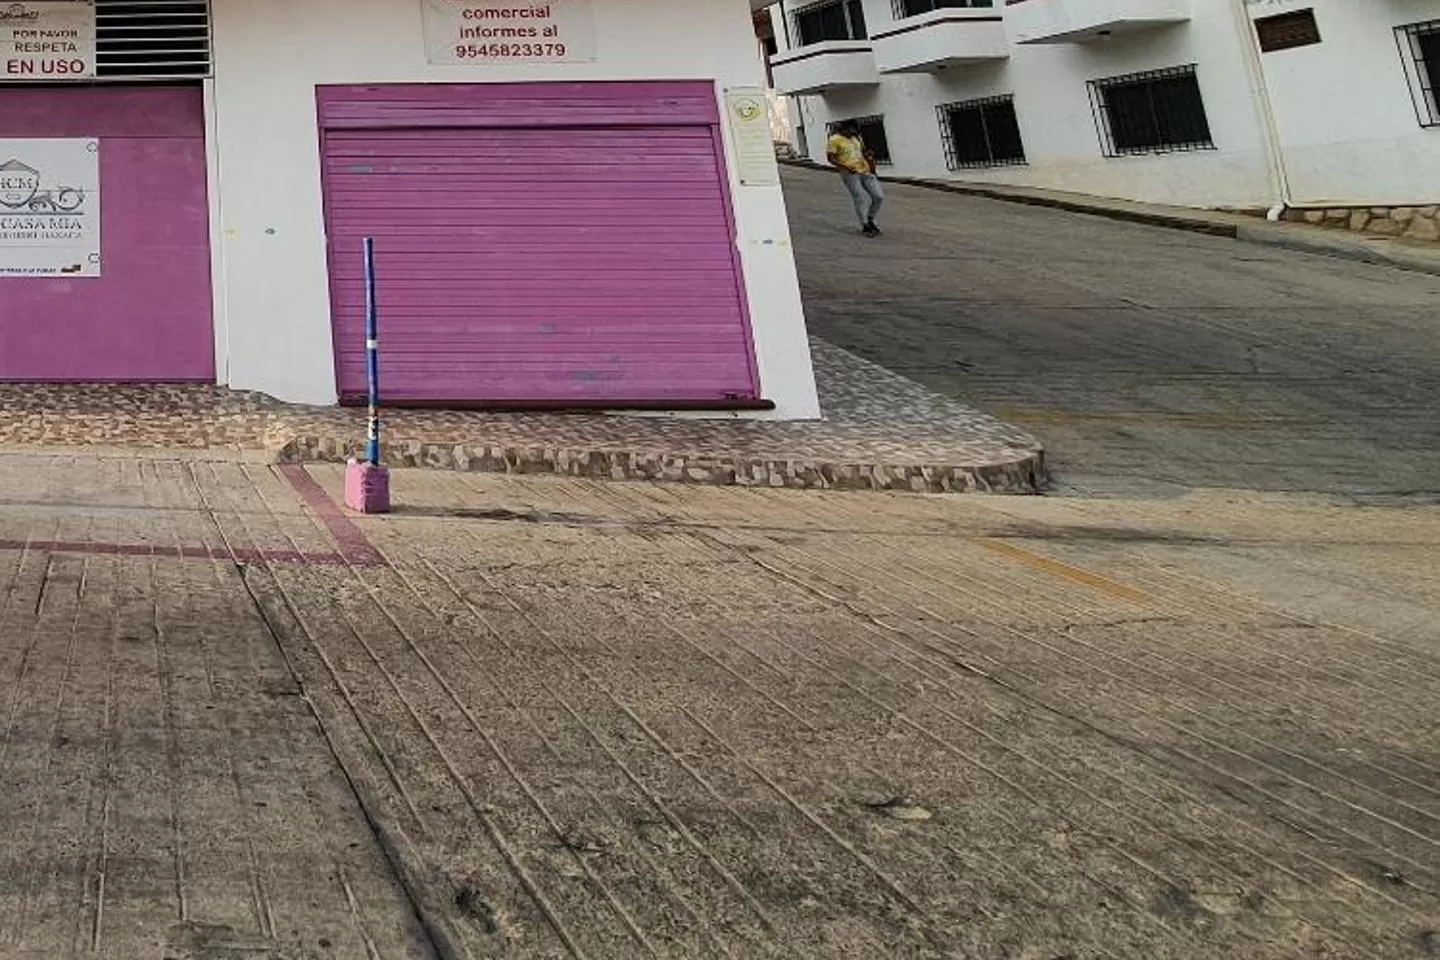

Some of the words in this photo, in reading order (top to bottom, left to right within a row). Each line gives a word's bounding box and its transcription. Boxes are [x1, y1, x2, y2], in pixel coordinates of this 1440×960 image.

[462, 5, 551, 19] comercial
[13, 29, 38, 39] POR
[40, 29, 78, 39] FAVOR
[460, 25, 537, 39] informes
[542, 25, 558, 38] al
[14, 42, 77, 53] RESPETA
[456, 43, 566, 58] 9545823379
[7, 60, 33, 74] EN
[42, 59, 85, 74] USO
[1, 217, 46, 230] CASA
[49, 217, 82, 230] MIA
